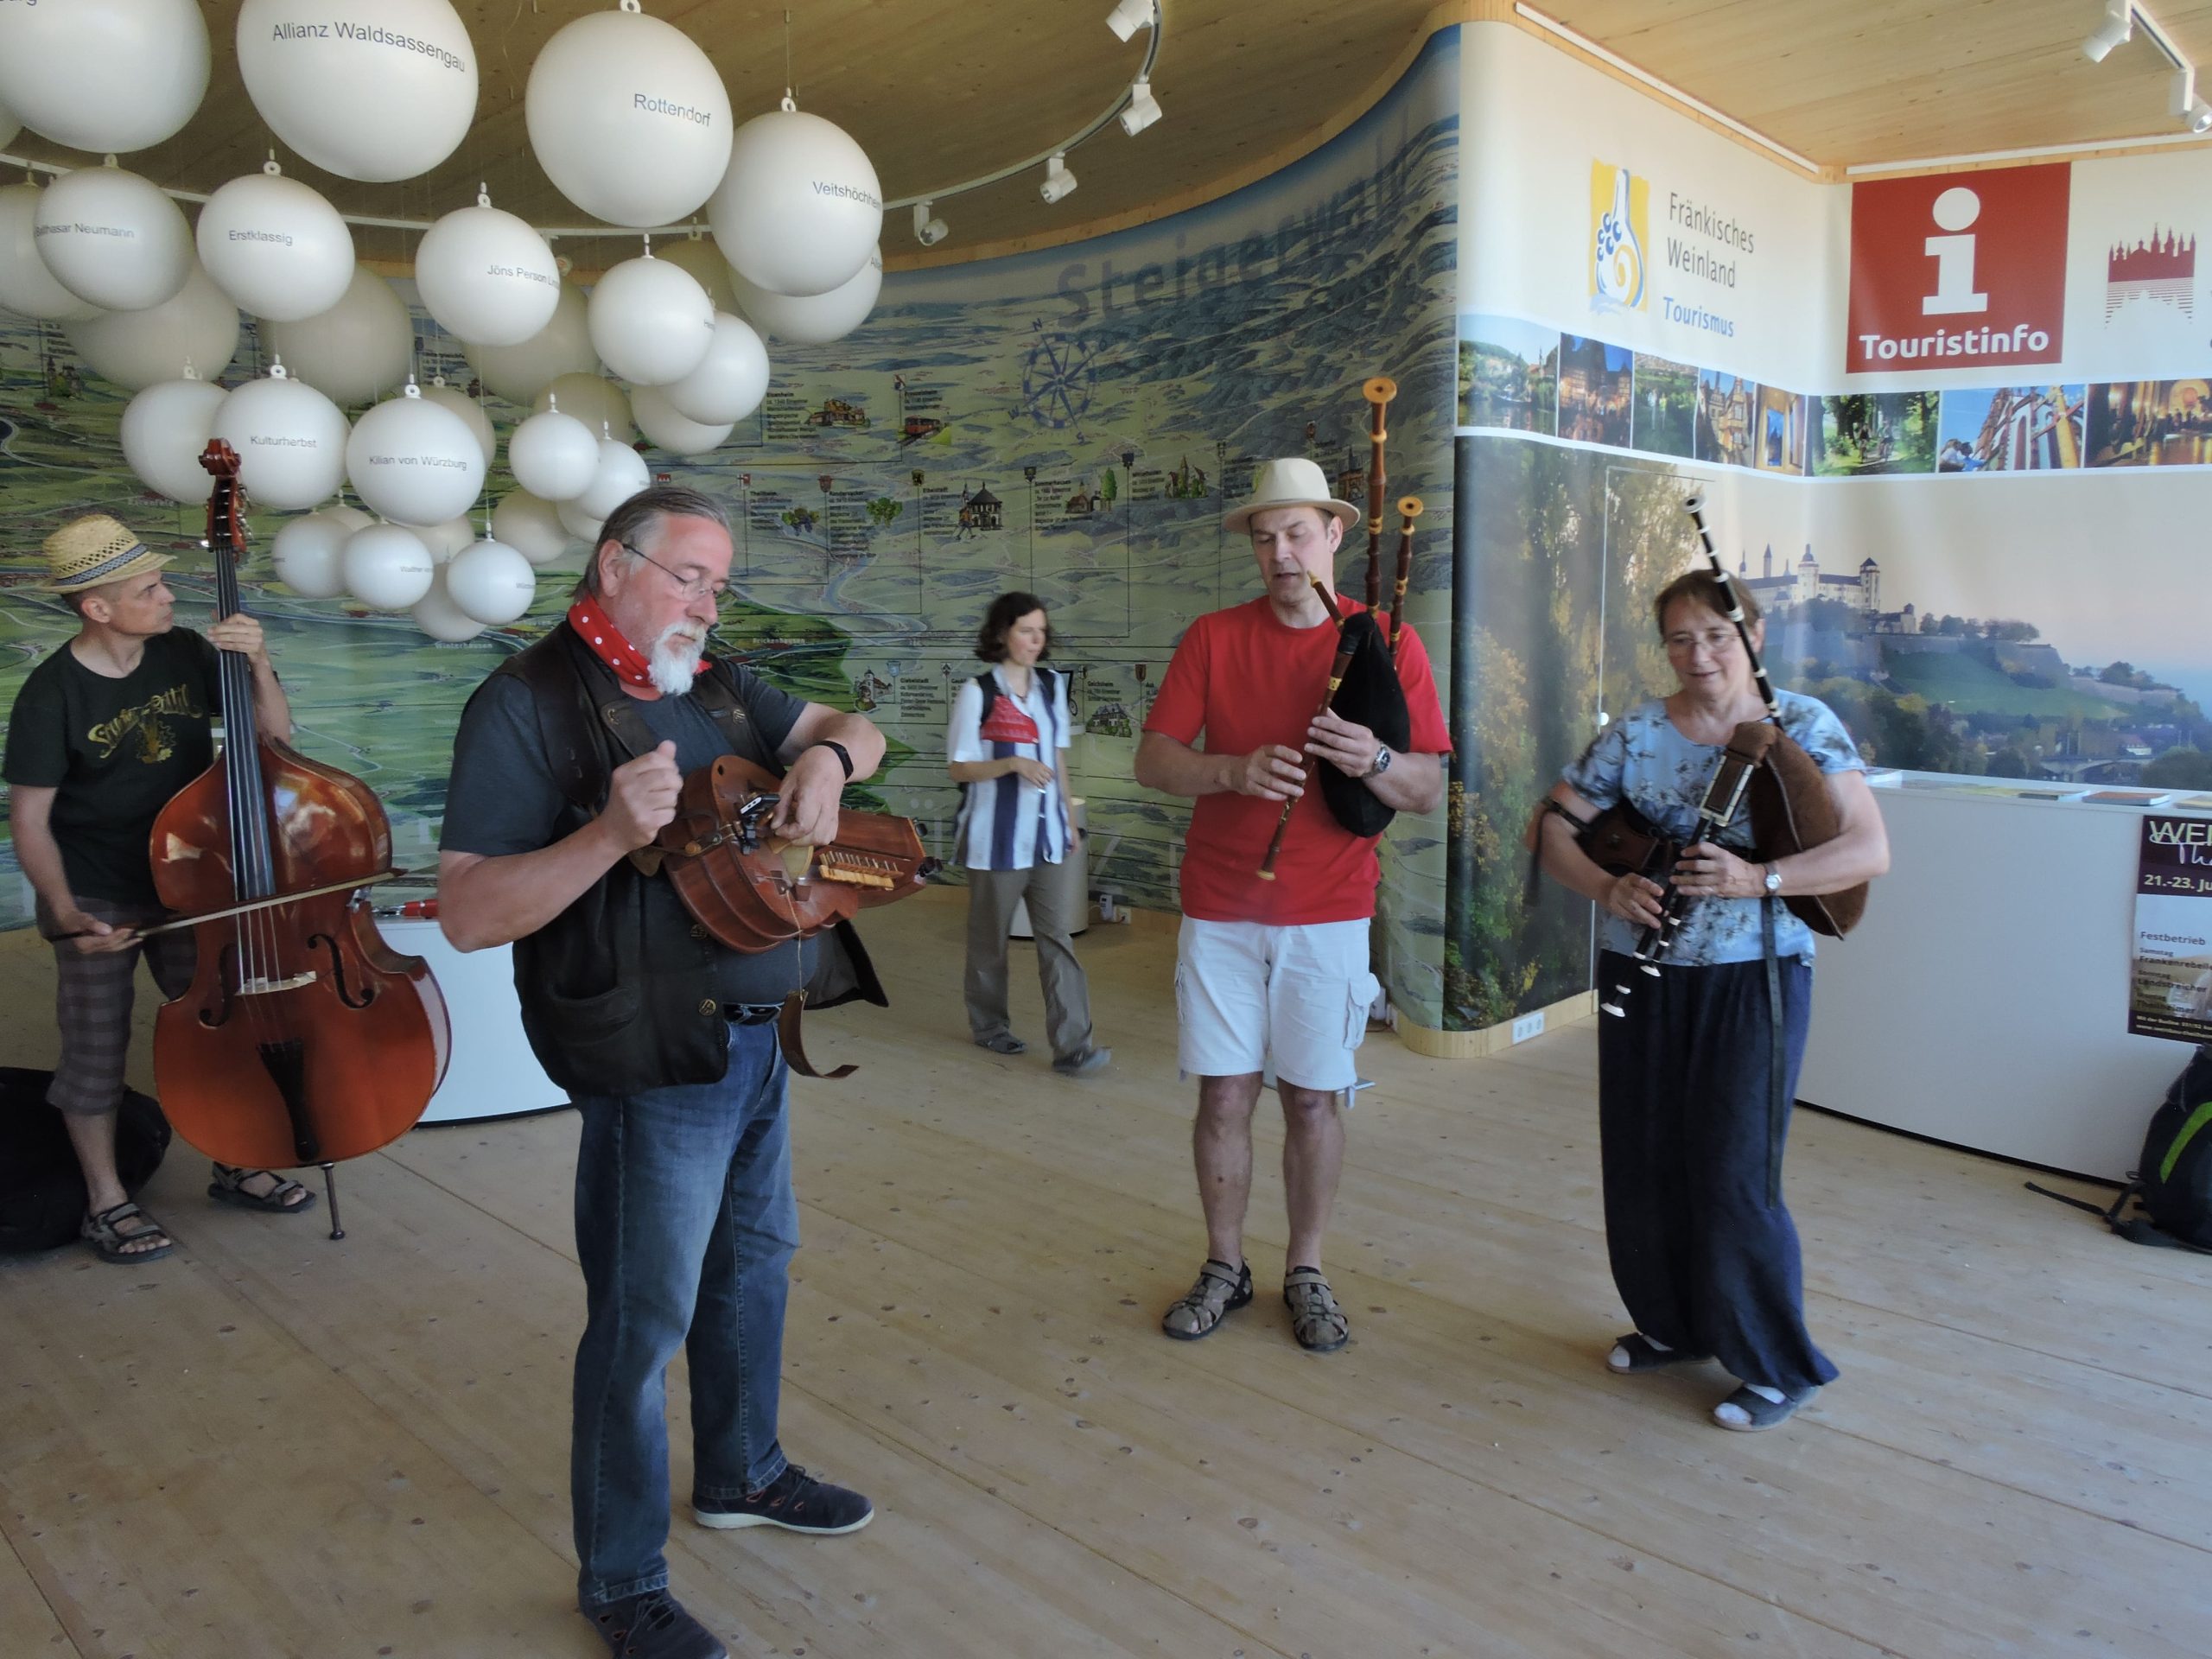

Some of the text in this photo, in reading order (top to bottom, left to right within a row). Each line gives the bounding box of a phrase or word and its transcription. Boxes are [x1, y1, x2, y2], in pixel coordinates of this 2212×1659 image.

[272, 22, 466, 73] Allianz Waldsassengau
[633, 92, 711, 128] Rottendorf
[74, 223, 135, 238] Neumann
[1669, 190, 1755, 255] Fränkisches
[228, 230, 293, 246] Erstklassig
[486, 264, 513, 277] Jöns
[1667, 237, 1737, 289] Weinland
[1662, 295, 1735, 339] Tourismus
[1859, 323, 2050, 360] Touristinfo
[250, 435, 317, 448] Kulturherbst
[369, 454, 467, 472] Kilian von Würzburg
[2144, 874, 2196, 889] 21.-23.
[2139, 931, 2206, 945] Festbetrieb
[2139, 947, 2174, 957] Samstag
[2138, 978, 2207, 993] Landstreicher
